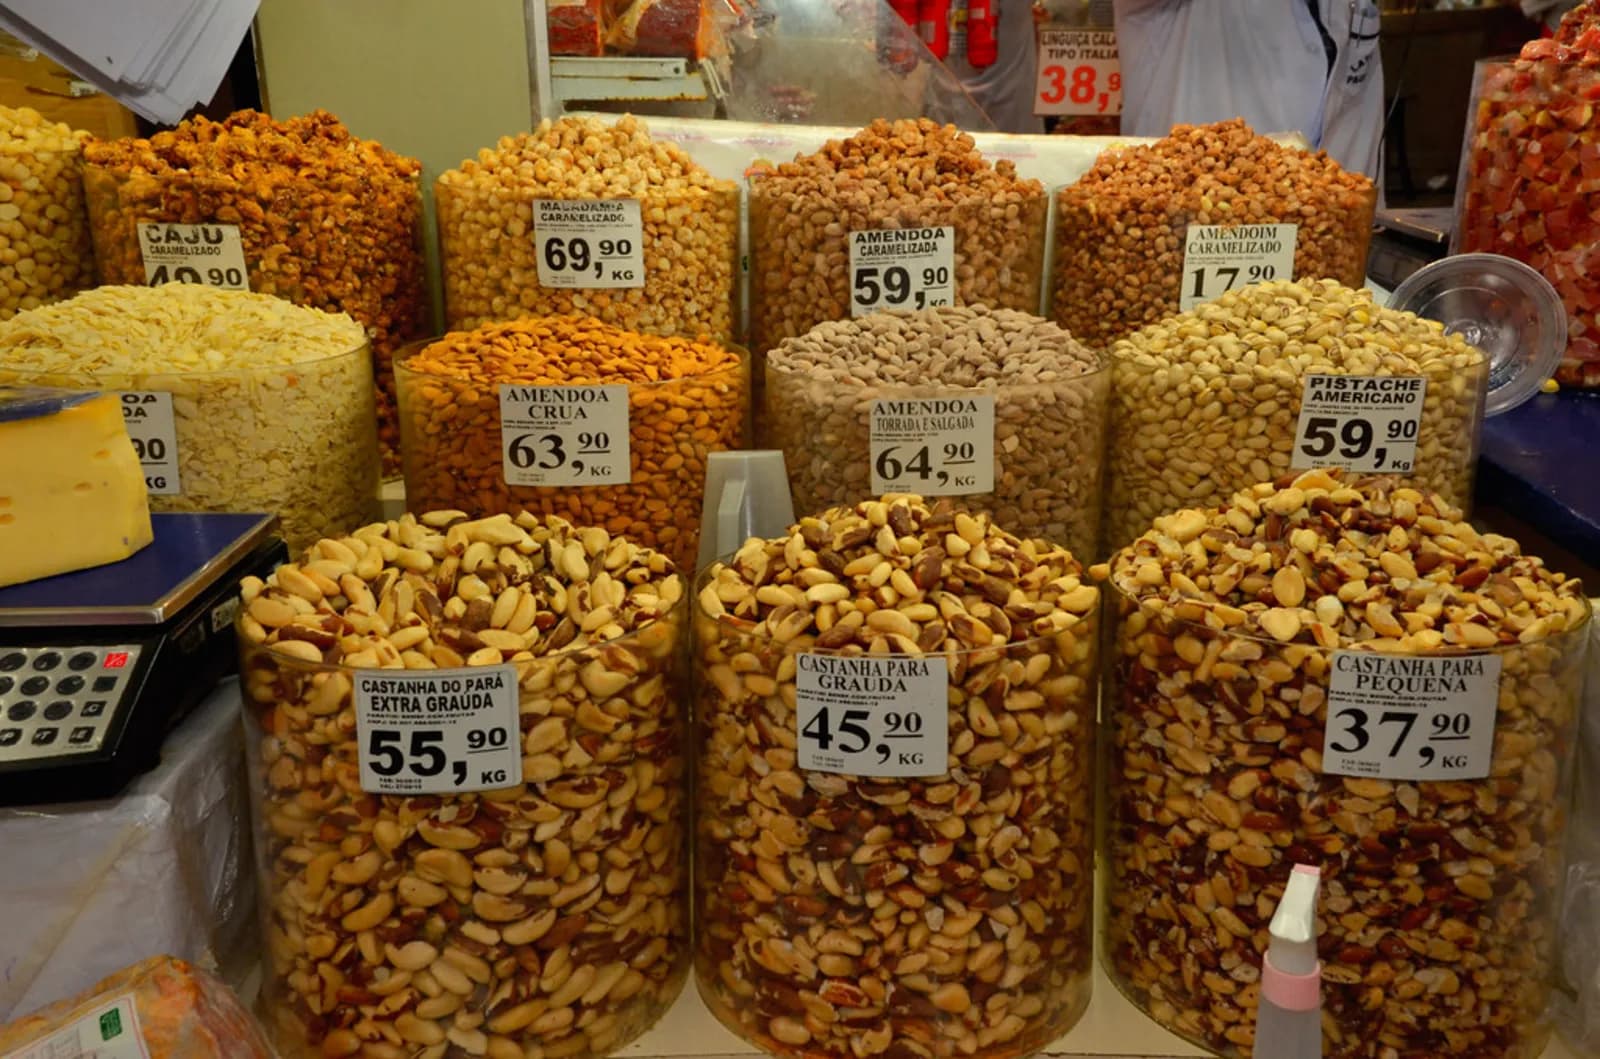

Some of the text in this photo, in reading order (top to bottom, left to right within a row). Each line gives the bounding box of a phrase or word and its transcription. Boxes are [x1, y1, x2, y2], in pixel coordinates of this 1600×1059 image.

[1048, 49, 1076, 59] TIPO
[540, 213, 624, 222] CARAMELIZADO
[145, 224, 223, 245] CAJU
[855, 228, 945, 244] AMENDOA
[1196, 226, 1277, 240] AMENDOIM
[149, 245, 221, 256] CARAMELIZADO
[860, 242, 938, 256] CARAMELIZADA
[1188, 241, 1282, 254] CARAMELIZADO
[612, 270, 634, 280] KG
[1310, 377, 1421, 391] PISTACHE
[506, 388, 609, 403] AMENDOA
[1312, 390, 1416, 404] AMERICANO
[528, 404, 587, 420] CRUA
[873, 400, 977, 415] AMENDOA
[877, 418, 920, 432] TORRADA
[930, 416, 975, 431] SALGADA
[590, 466, 611, 476] KG
[955, 476, 975, 486] KG
[799, 654, 929, 677] CASTANHA PARA
[1337, 655, 1485, 677] CASTANHA PARA
[362, 672, 504, 694] CASTANHA DO PARÁ
[818, 674, 907, 693] GRAUDA
[1356, 674, 1468, 695] PEQUENA
[371, 696, 422, 713] EXTRA
[899, 752, 924, 765] KG
[1442, 756, 1468, 769] KG
[481, 770, 506, 784] KG
